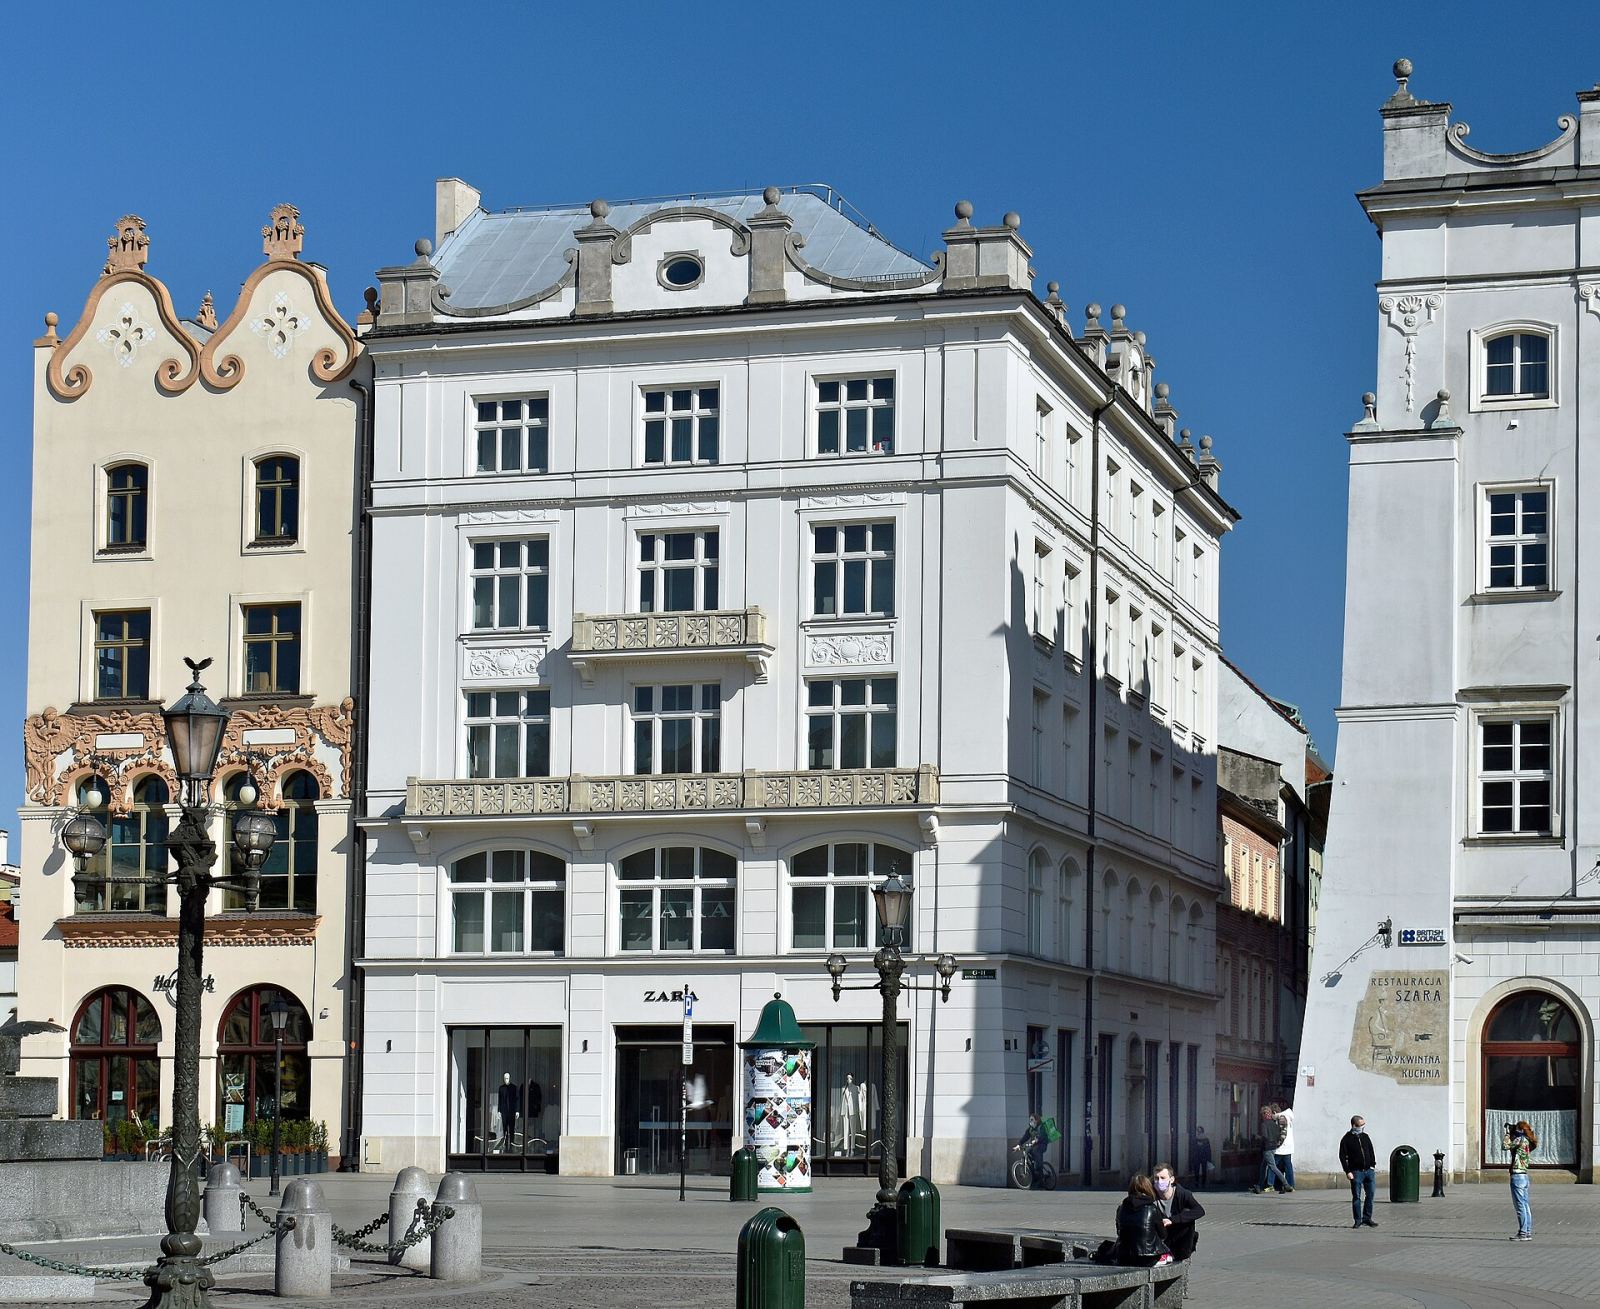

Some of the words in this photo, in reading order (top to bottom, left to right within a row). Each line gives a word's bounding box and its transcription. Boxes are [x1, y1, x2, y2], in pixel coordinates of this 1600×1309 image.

[153, 975, 178, 990] Har
[1371, 977, 1442, 986] RESTAURACJA
[643, 991, 700, 1002] ZARA
[1395, 990, 1442, 1002] SZARA
[686, 997, 692, 1015] P
[1386, 1055, 1441, 1064] WYKWINTNA
[1402, 1069, 1441, 1078] KUCHNIA
